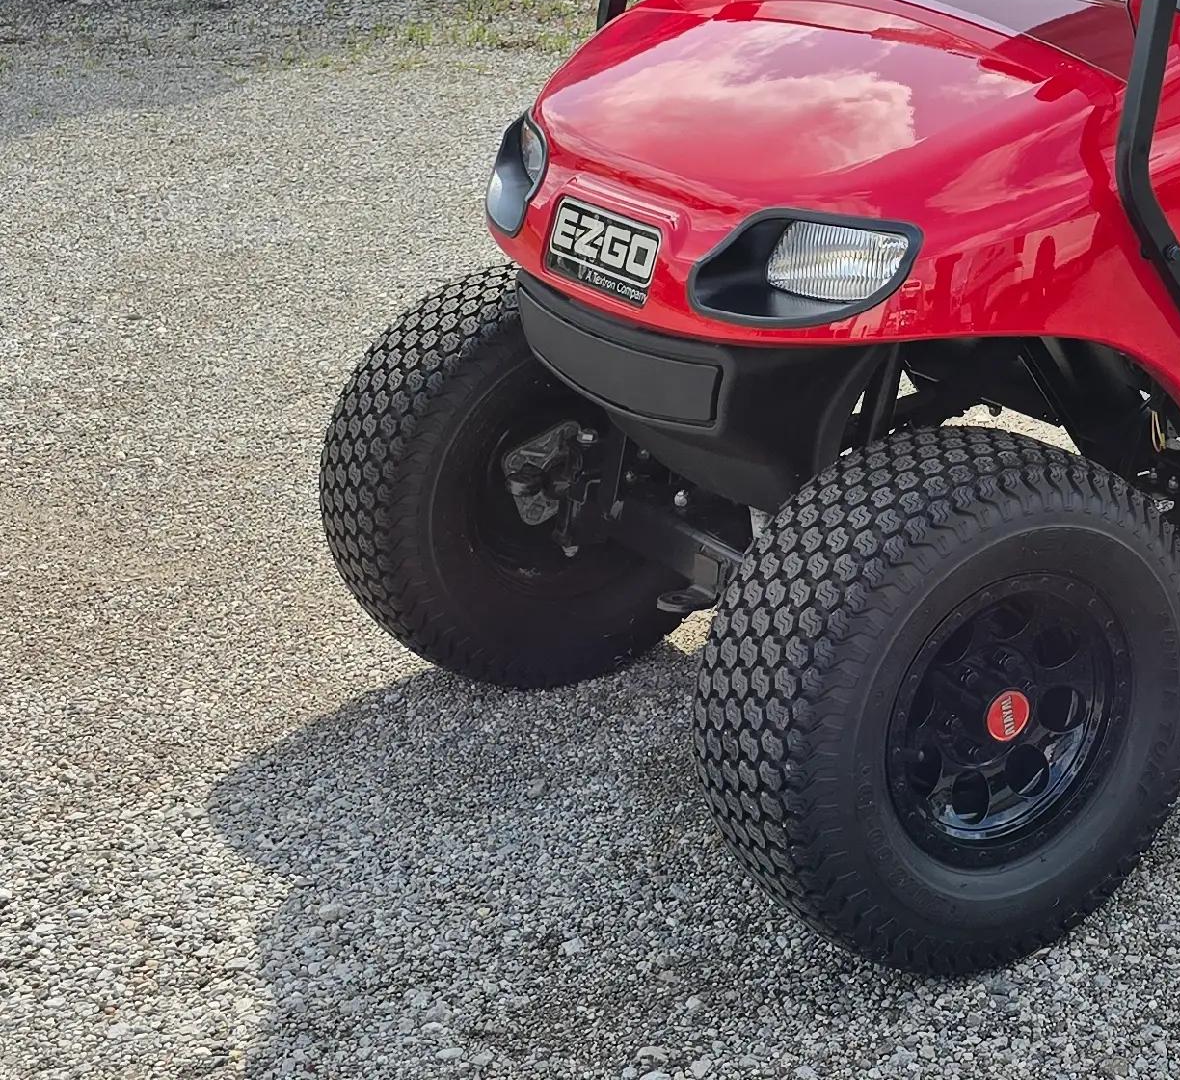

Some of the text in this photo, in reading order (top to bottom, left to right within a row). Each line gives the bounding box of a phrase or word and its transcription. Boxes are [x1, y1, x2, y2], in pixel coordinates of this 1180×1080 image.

[585, 270, 648, 304] A Textron Company
